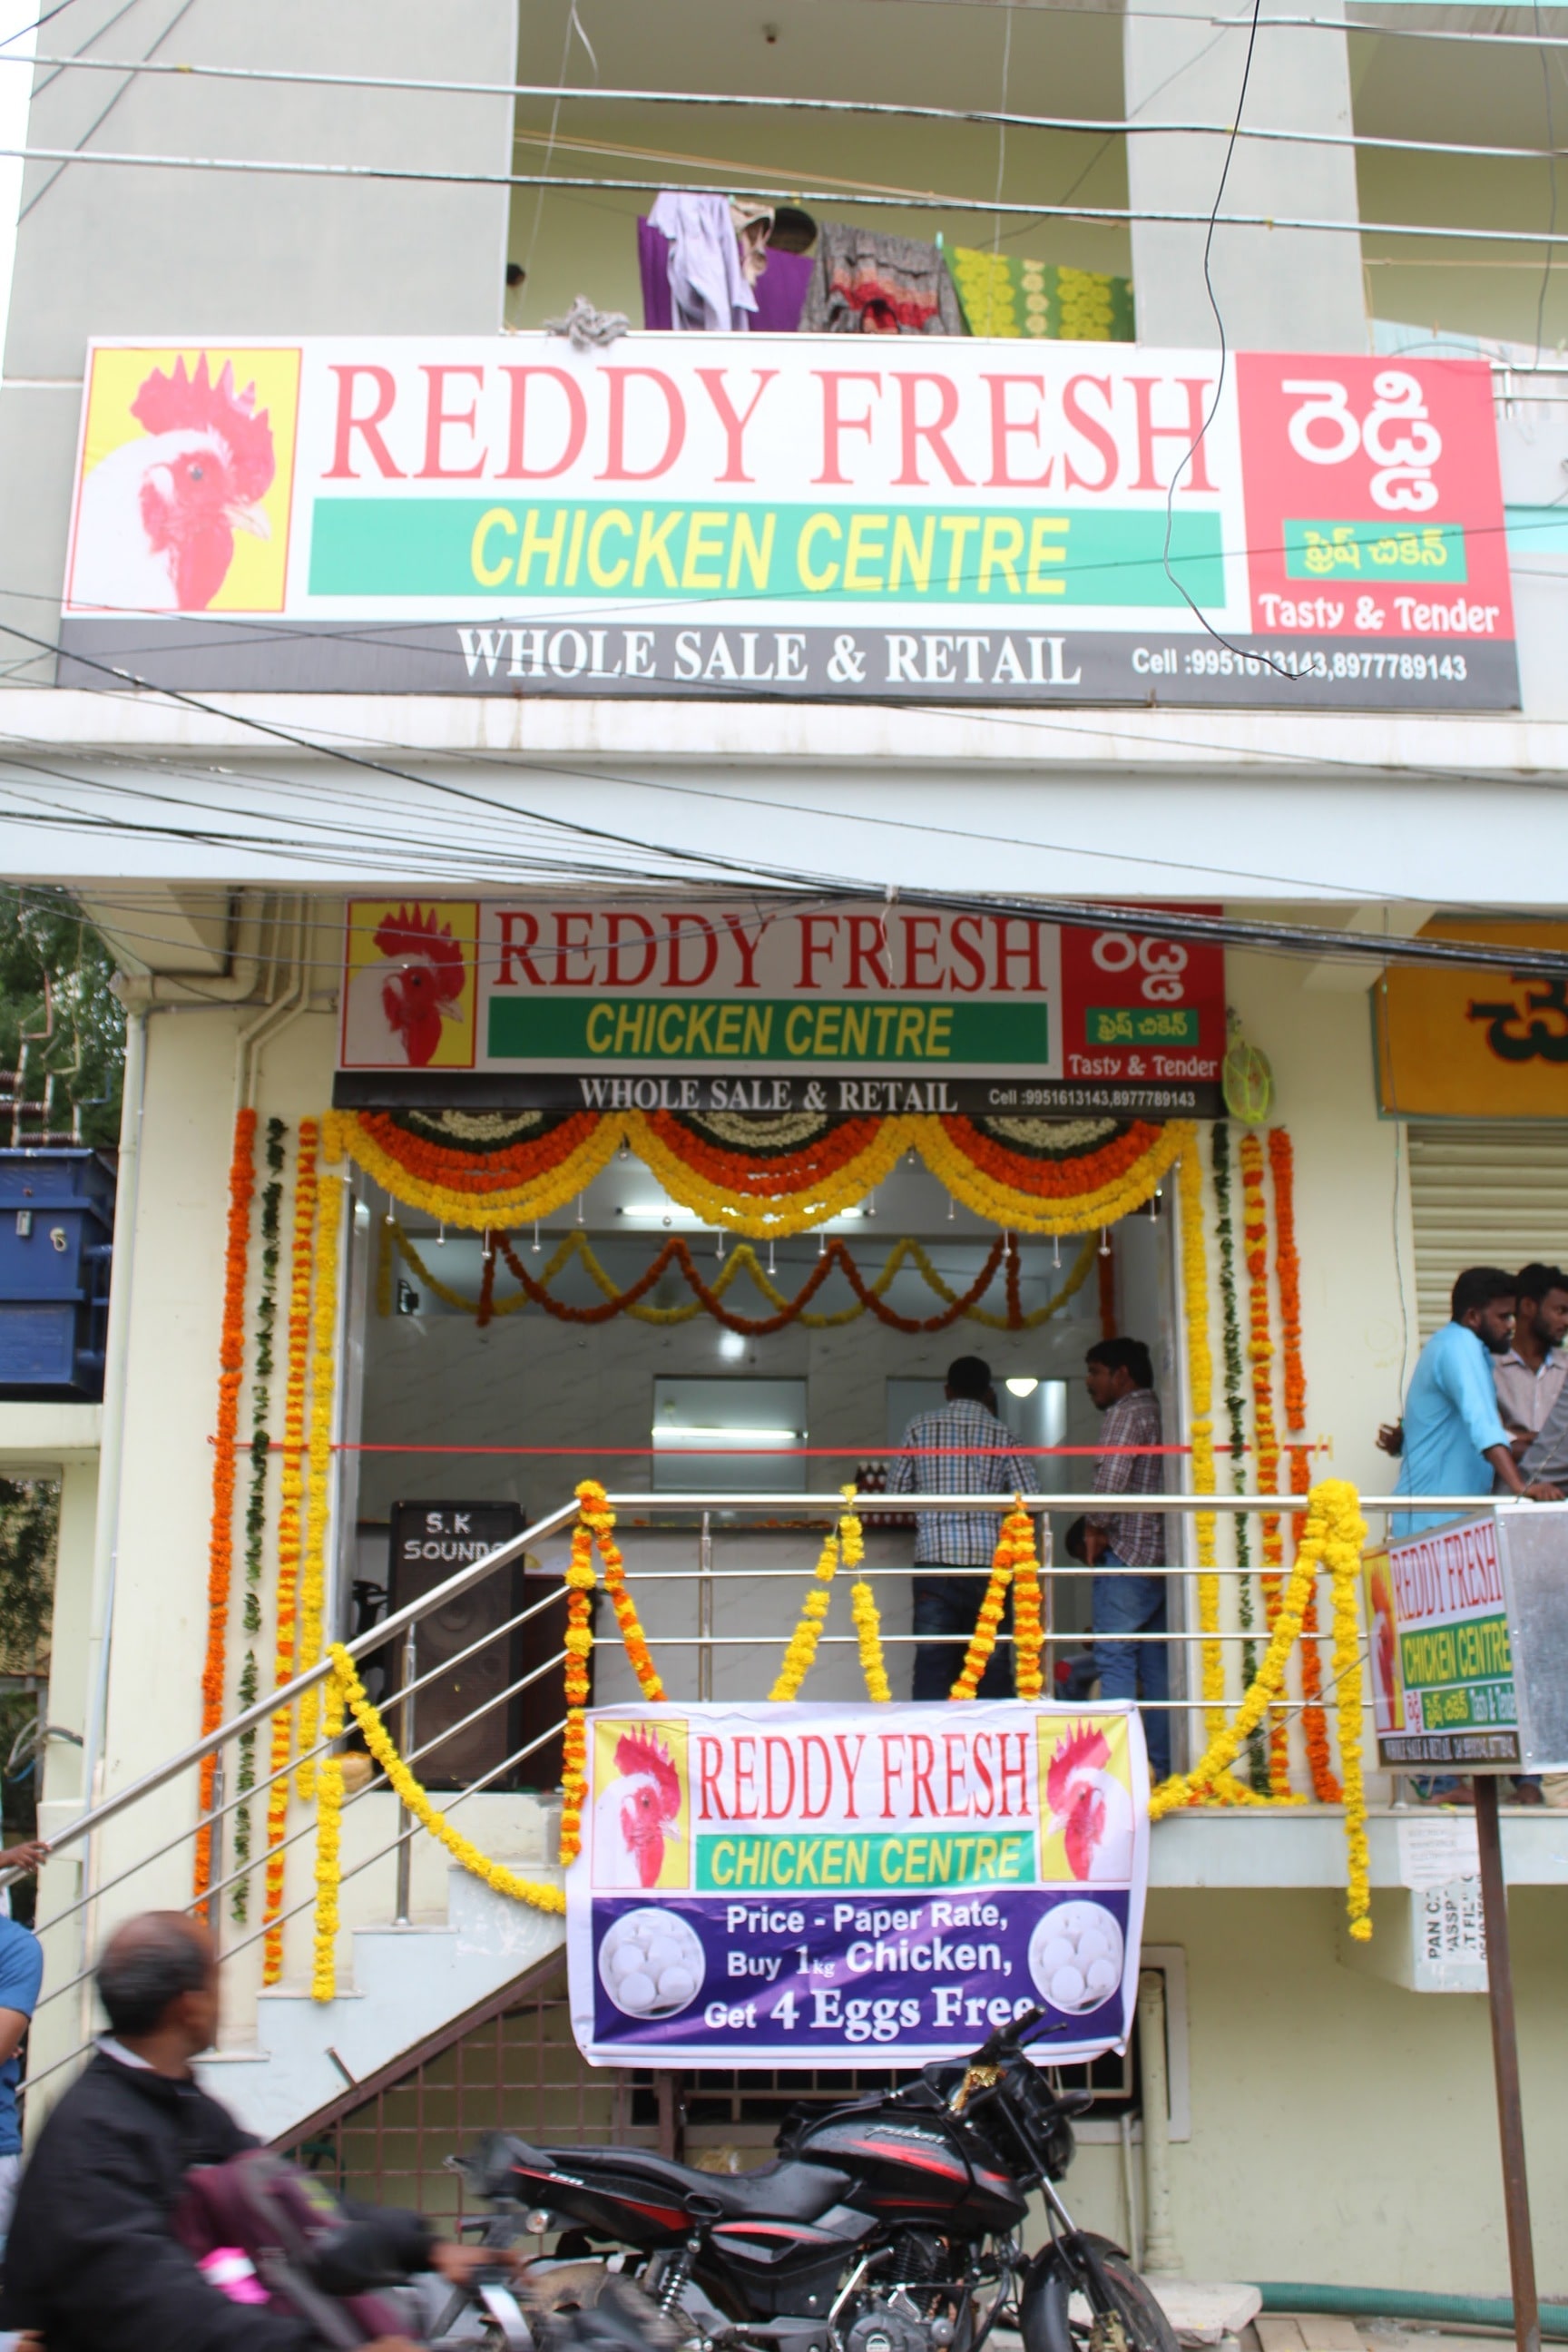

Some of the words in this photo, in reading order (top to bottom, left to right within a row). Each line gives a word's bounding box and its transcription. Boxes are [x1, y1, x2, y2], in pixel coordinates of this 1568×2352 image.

[320, 365, 780, 483] REDDY
[809, 369, 1220, 493] FRESH
[1281, 370, 1443, 512] రెడ్డి
[470, 507, 778, 590] CHICKEN
[797, 512, 1071, 594] CENTRE
[1259, 593, 1344, 630] Tasty
[1355, 595, 1386, 630] &
[1394, 596, 1500, 632] Tender
[456, 628, 656, 681] WHOLE
[673, 632, 808, 682] SALE
[827, 633, 867, 682] &
[885, 634, 1082, 684] RETAIL
[1132, 648, 1178, 673] Cell
[493, 911, 777, 987] REDDY
[793, 915, 1048, 993] FRESH
[586, 1003, 773, 1054] CHICKEN
[785, 1005, 954, 1057] CENTRE
[1069, 1054, 1122, 1076] Tasty
[1128, 1054, 1146, 1076] &
[1152, 1055, 1218, 1077] Tender
[579, 1078, 700, 1110] WHOLE
[710, 1080, 791, 1111] SALE
[804, 1081, 828, 1112] &
[838, 1082, 958, 1112] RETAIL
[989, 1089, 1016, 1105] Cell
[426, 1512, 472, 1534] S.K
[1391, 1539, 1445, 1622] REDDY
[1444, 1523, 1503, 1610] FRESH
[1405, 1630, 1456, 1685] CHICKEN
[1458, 1621, 1513, 1679] CENTRE
[697, 1734, 866, 1821] REDDY
[878, 1730, 1032, 1819] FRESH
[710, 1839, 871, 1886] CHICKEN
[879, 1836, 1022, 1883] CENTRE
[727, 1905, 805, 1933] Price
[834, 1904, 922, 1937] Paper
[931, 1900, 1008, 1931] Rate,
[1427, 1921, 1442, 1960] PAN
[727, 1951, 782, 1981] Buy
[846, 1936, 1012, 1977] Chicken,
[704, 2002, 757, 2028] Get
[770, 1990, 799, 2030] 4
[809, 1987, 921, 2043] Eggs
